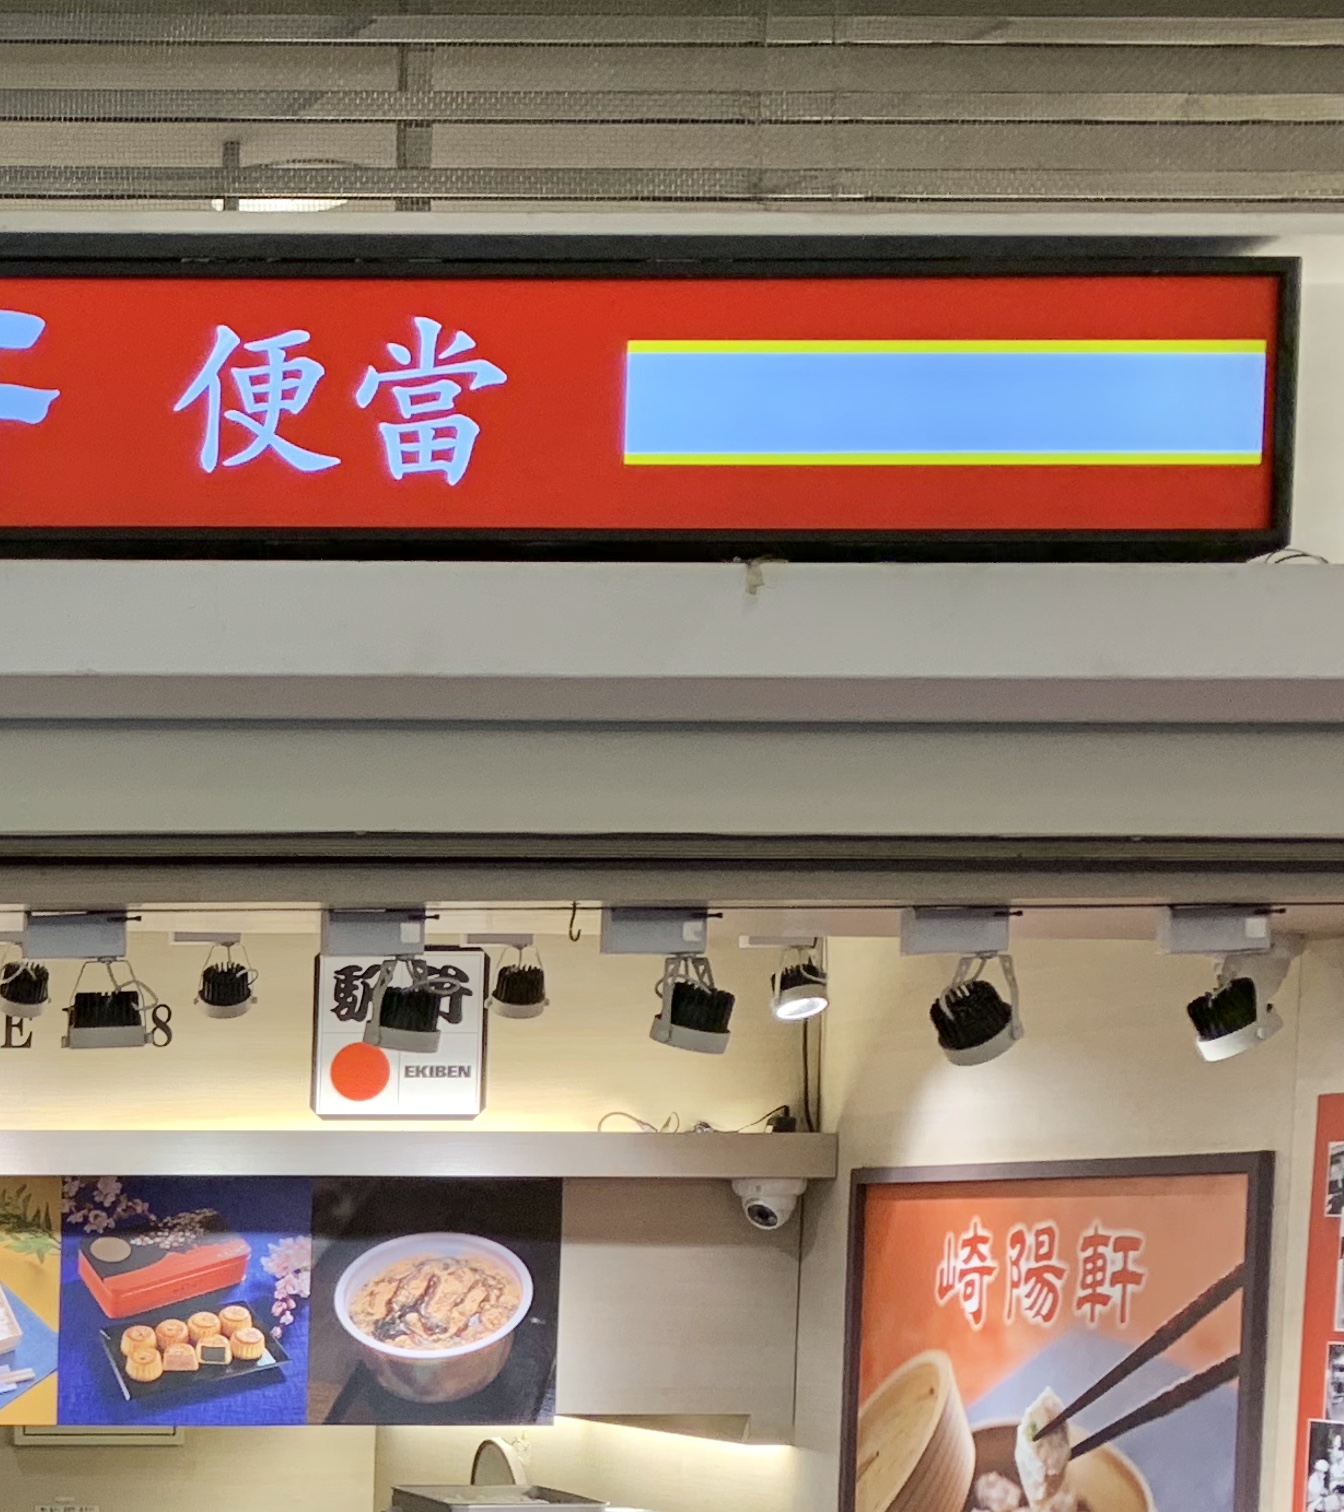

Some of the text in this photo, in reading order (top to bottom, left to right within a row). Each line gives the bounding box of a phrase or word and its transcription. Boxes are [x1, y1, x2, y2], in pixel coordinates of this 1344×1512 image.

[173, 316, 509, 487] 便當
[404, 1065, 471, 1078] EKIBEN
[937, 1218, 1146, 1328] 崎陽軒
